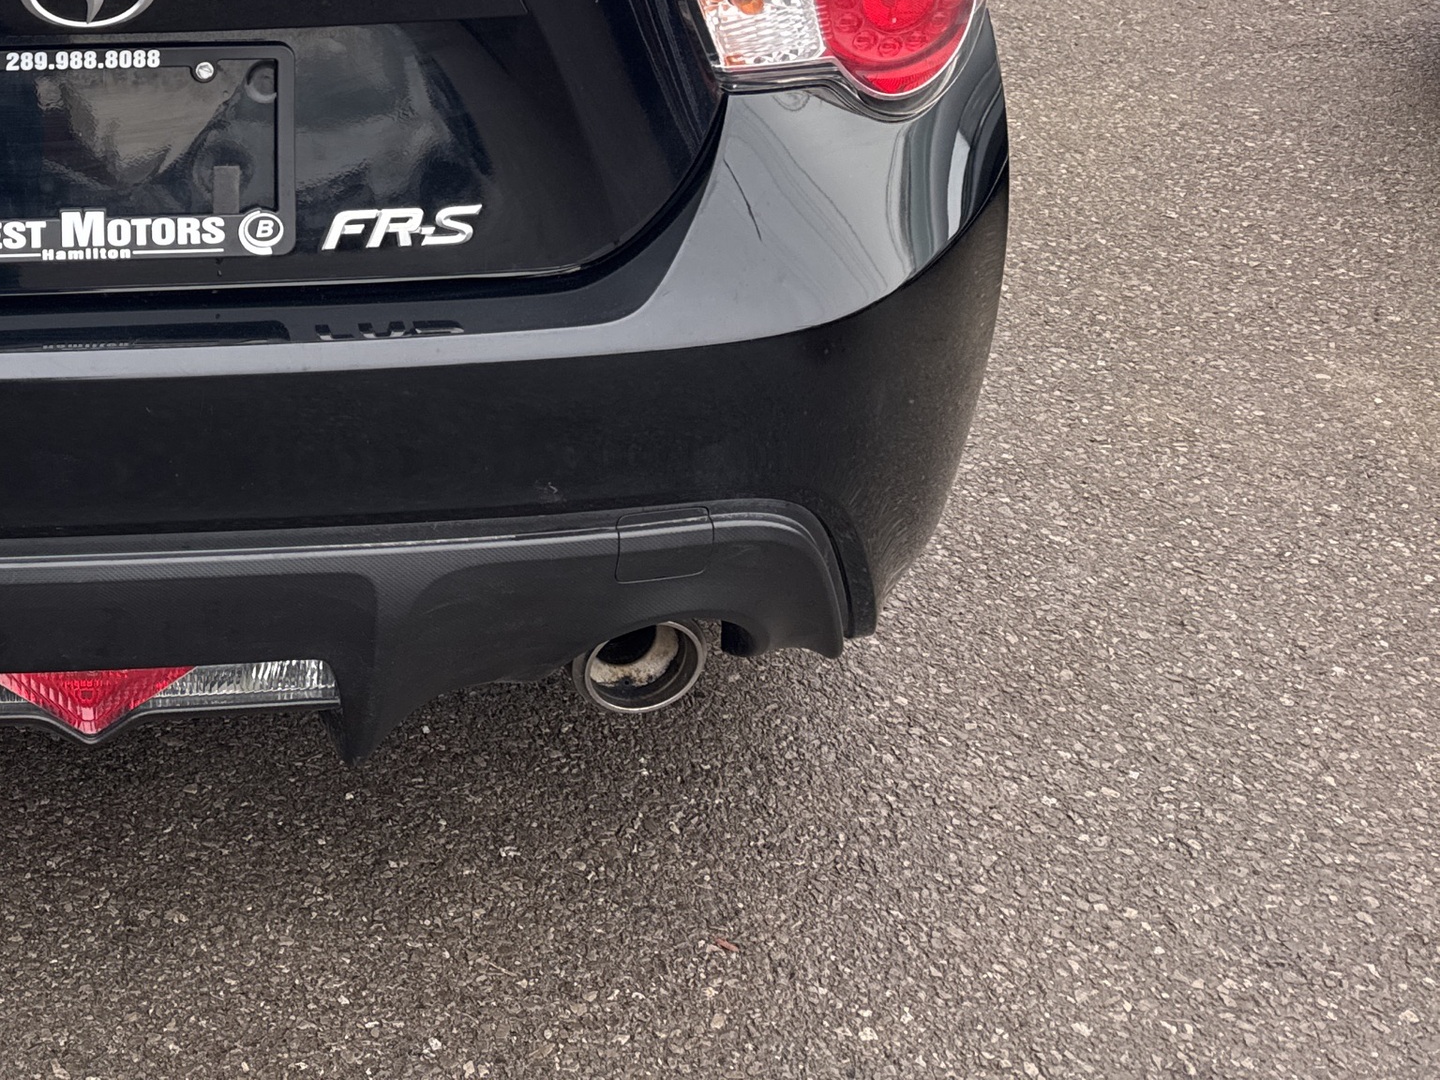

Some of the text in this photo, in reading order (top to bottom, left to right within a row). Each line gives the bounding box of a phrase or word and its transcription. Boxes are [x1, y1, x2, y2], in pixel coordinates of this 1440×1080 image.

[6, 49, 161, 71] 289.988.8088
[61, 211, 226, 248] MOTORS
[41, 248, 131, 261] Hamilton
